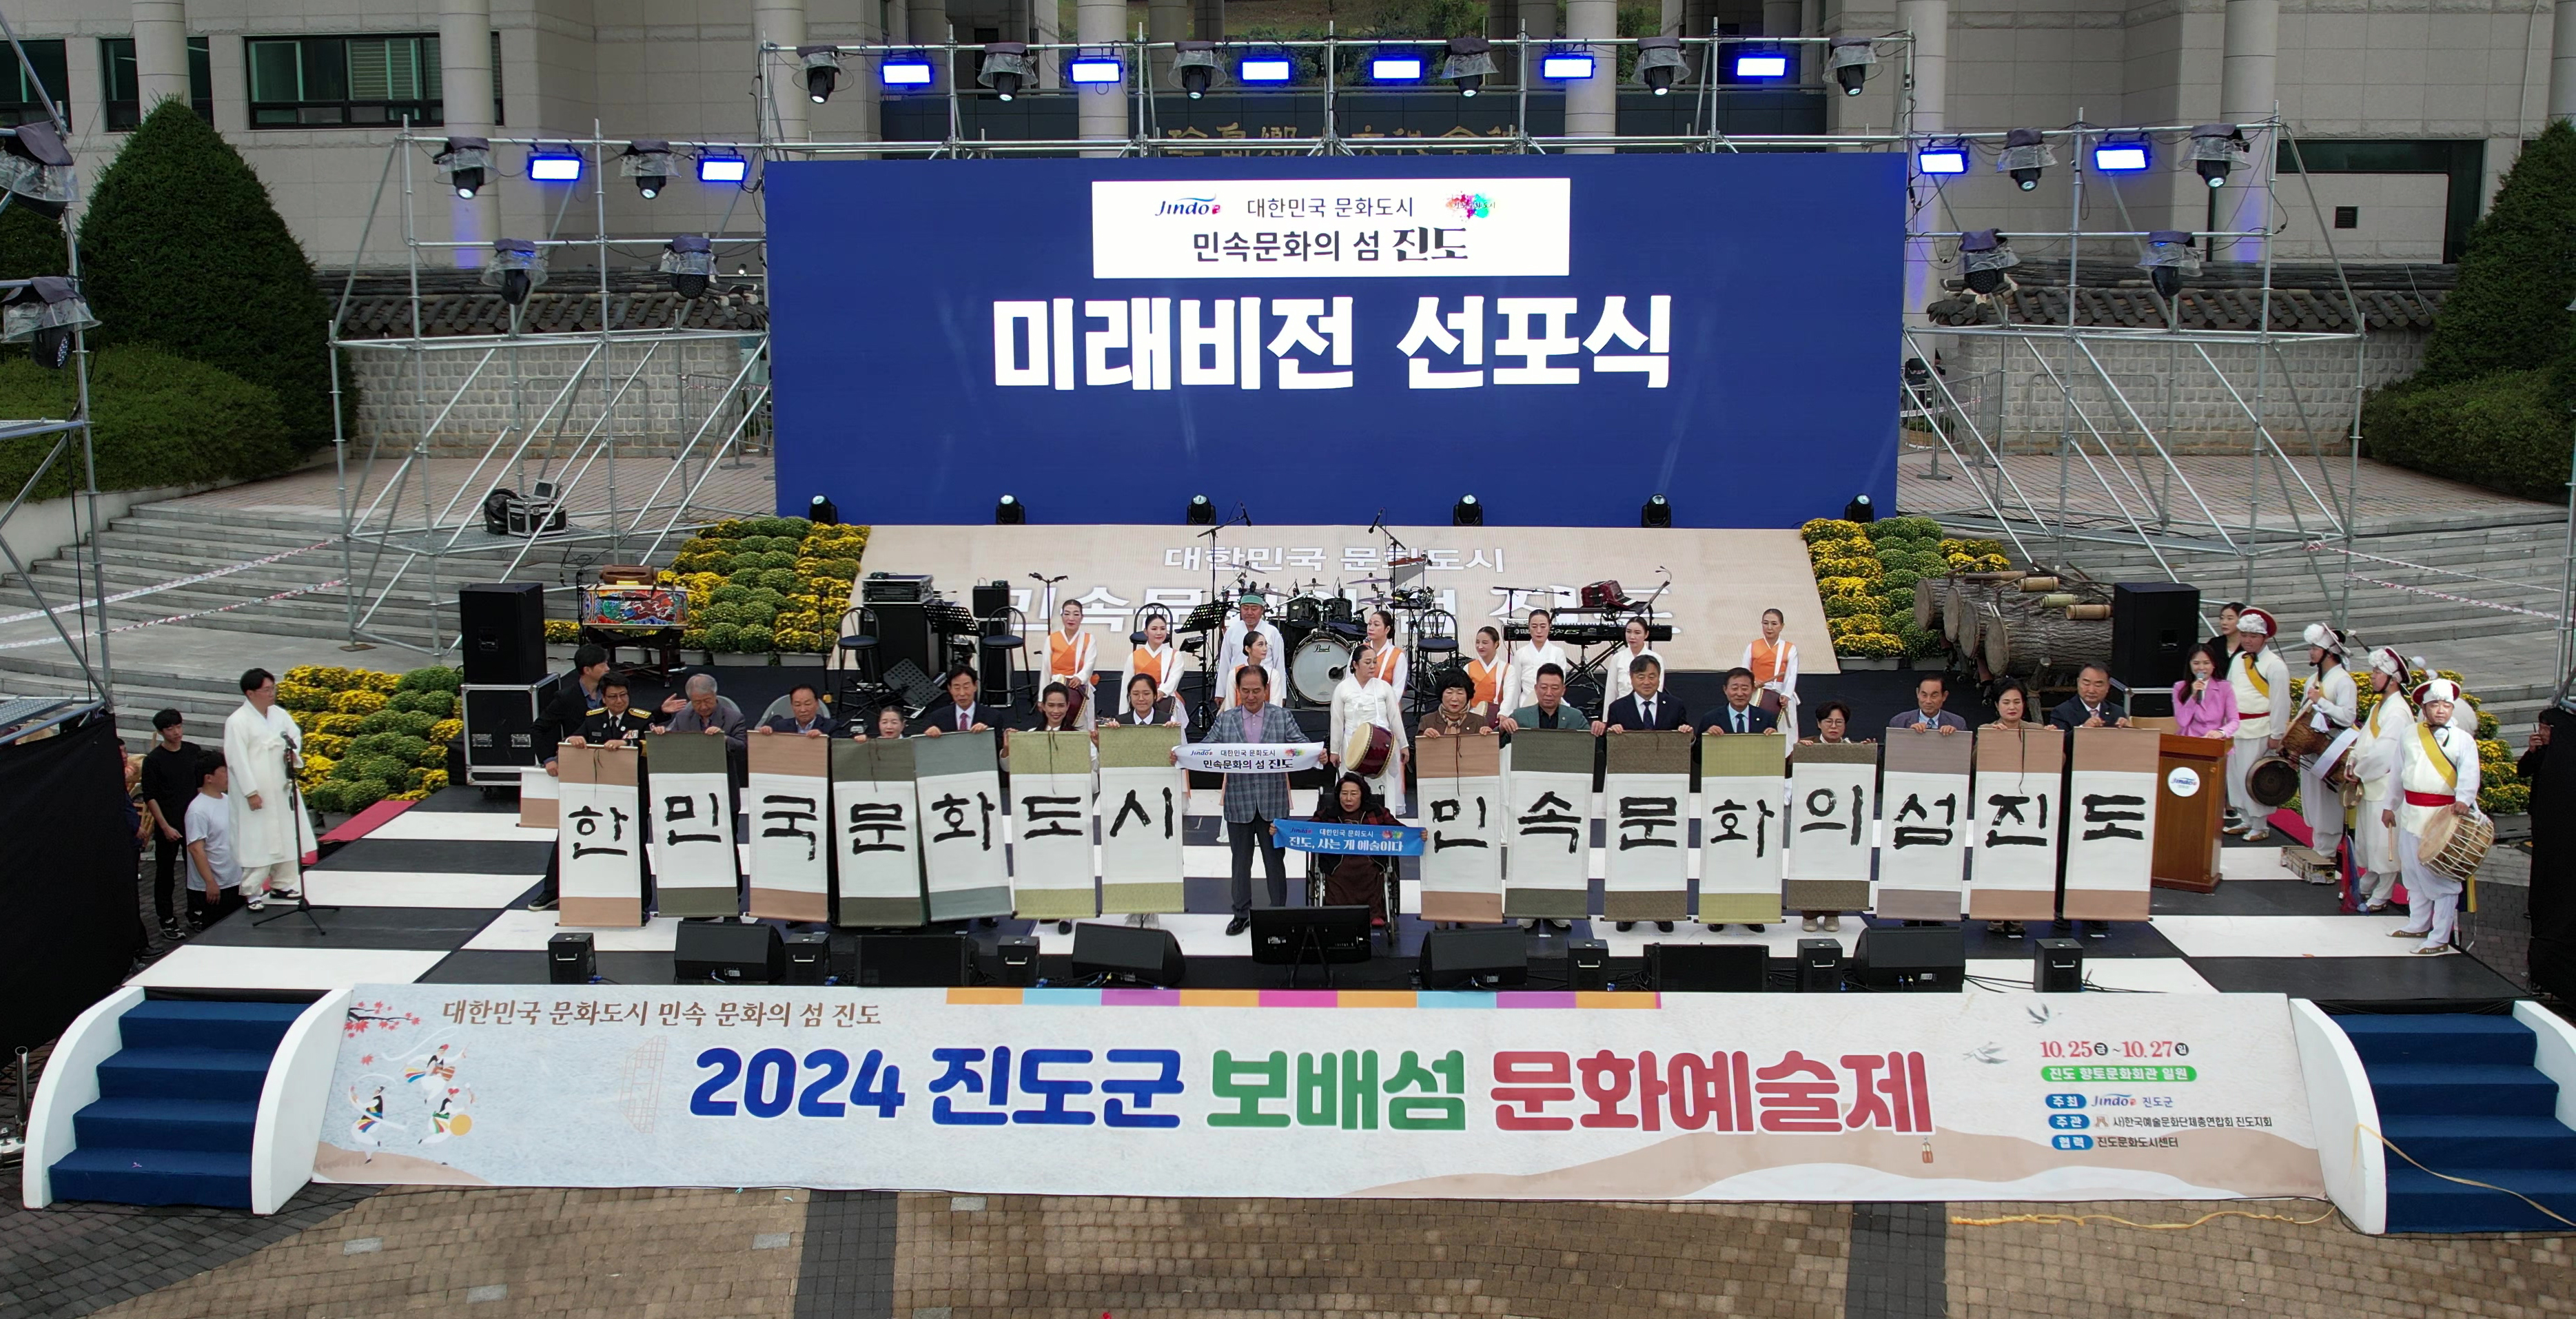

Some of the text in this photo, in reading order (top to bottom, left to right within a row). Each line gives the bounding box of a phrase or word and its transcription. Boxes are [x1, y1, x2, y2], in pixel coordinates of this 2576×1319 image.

[1247, 197, 1413, 218] 대한민국 문화도시
[1194, 226, 1468, 262] 민속문화의 섬 진도
[992, 294, 1671, 390] 미래비전 선포식
[1165, 546, 1327, 571] 대한민국
[1203, 759, 1294, 769] 민속문화의 섬 진도
[1289, 837, 1315, 850] 진도,
[1318, 838, 1340, 850] 사는
[1343, 839, 1354, 850] 게
[442, 999, 881, 1027] 대한민국 문화도시 민속 문화의 섬 진도
[2049, 1067, 2188, 1081] 진도 향토문화회관 일원
[689, 1045, 1932, 1134] 2024 진도군 보배섬 문화예술제
[2143, 1097, 2173, 1108] 진도군
[2236, 1116, 2272, 1127] 진도지회
[2097, 1136, 2178, 1148] 진도문화도시센터
